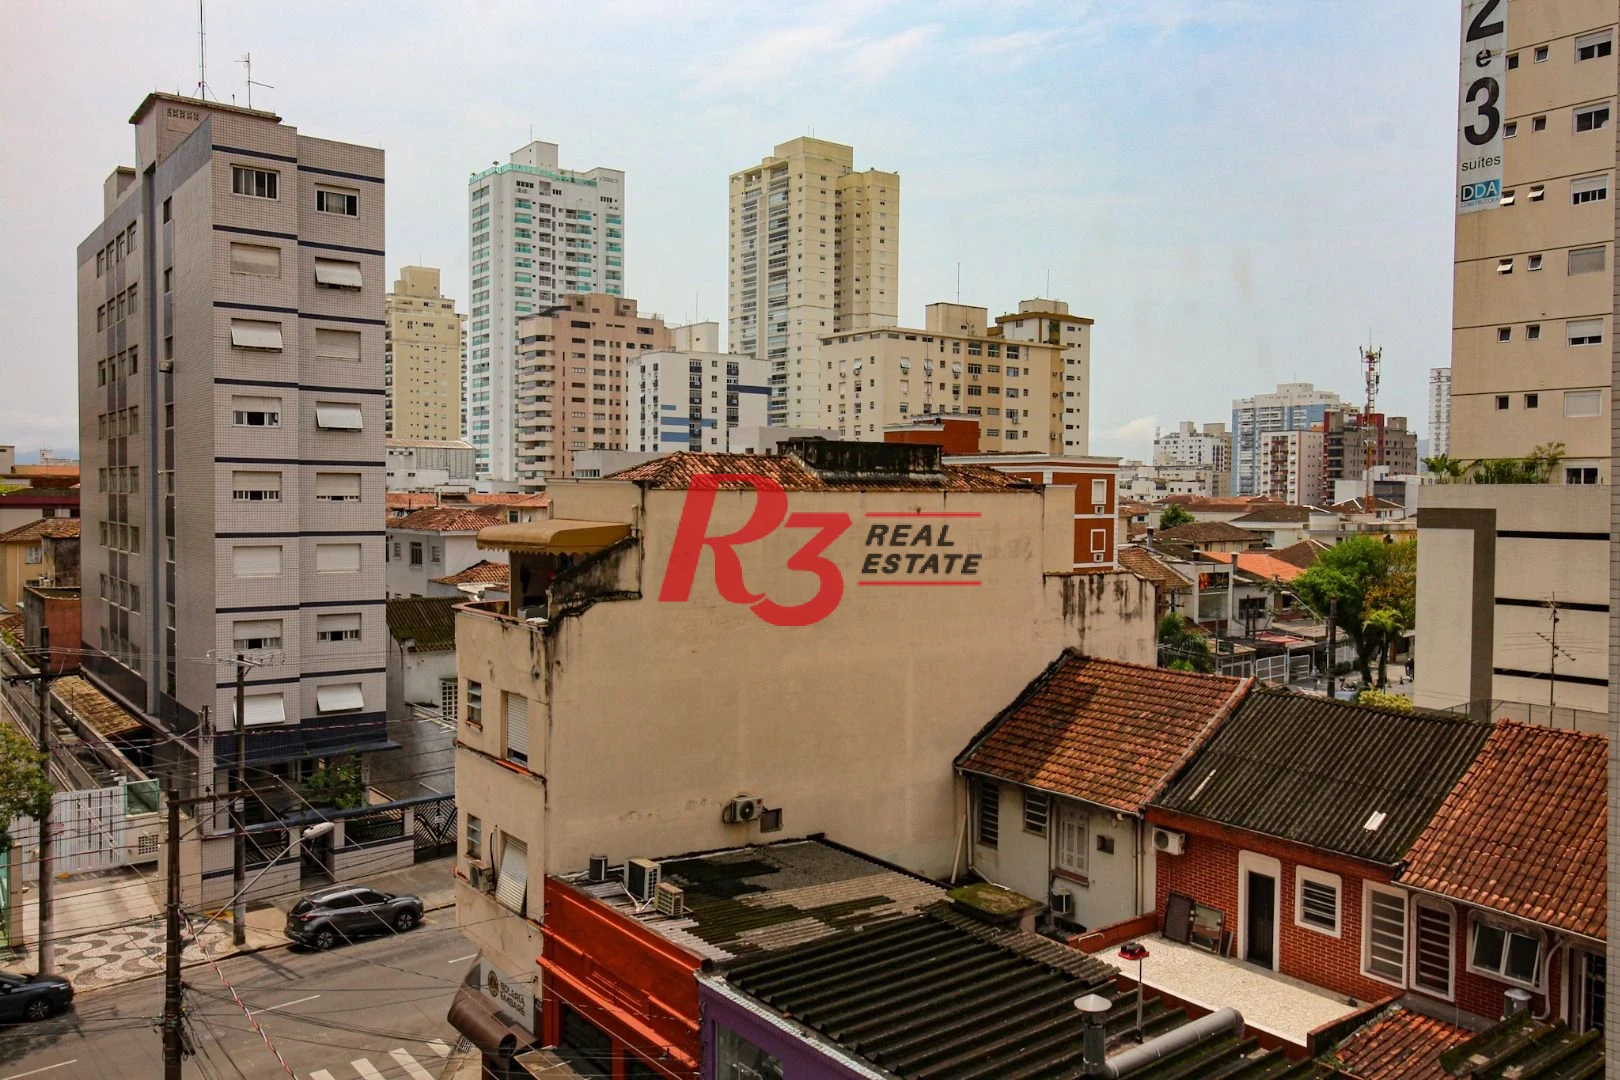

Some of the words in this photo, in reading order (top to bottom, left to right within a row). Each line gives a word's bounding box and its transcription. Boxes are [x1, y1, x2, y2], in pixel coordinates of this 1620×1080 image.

[1466, 0, 1504, 43] 2
[1475, 49, 1492, 68] e
[1464, 76, 1500, 146] 3
[1461, 156, 1501, 172] suites
[1462, 181, 1498, 200] DDA
